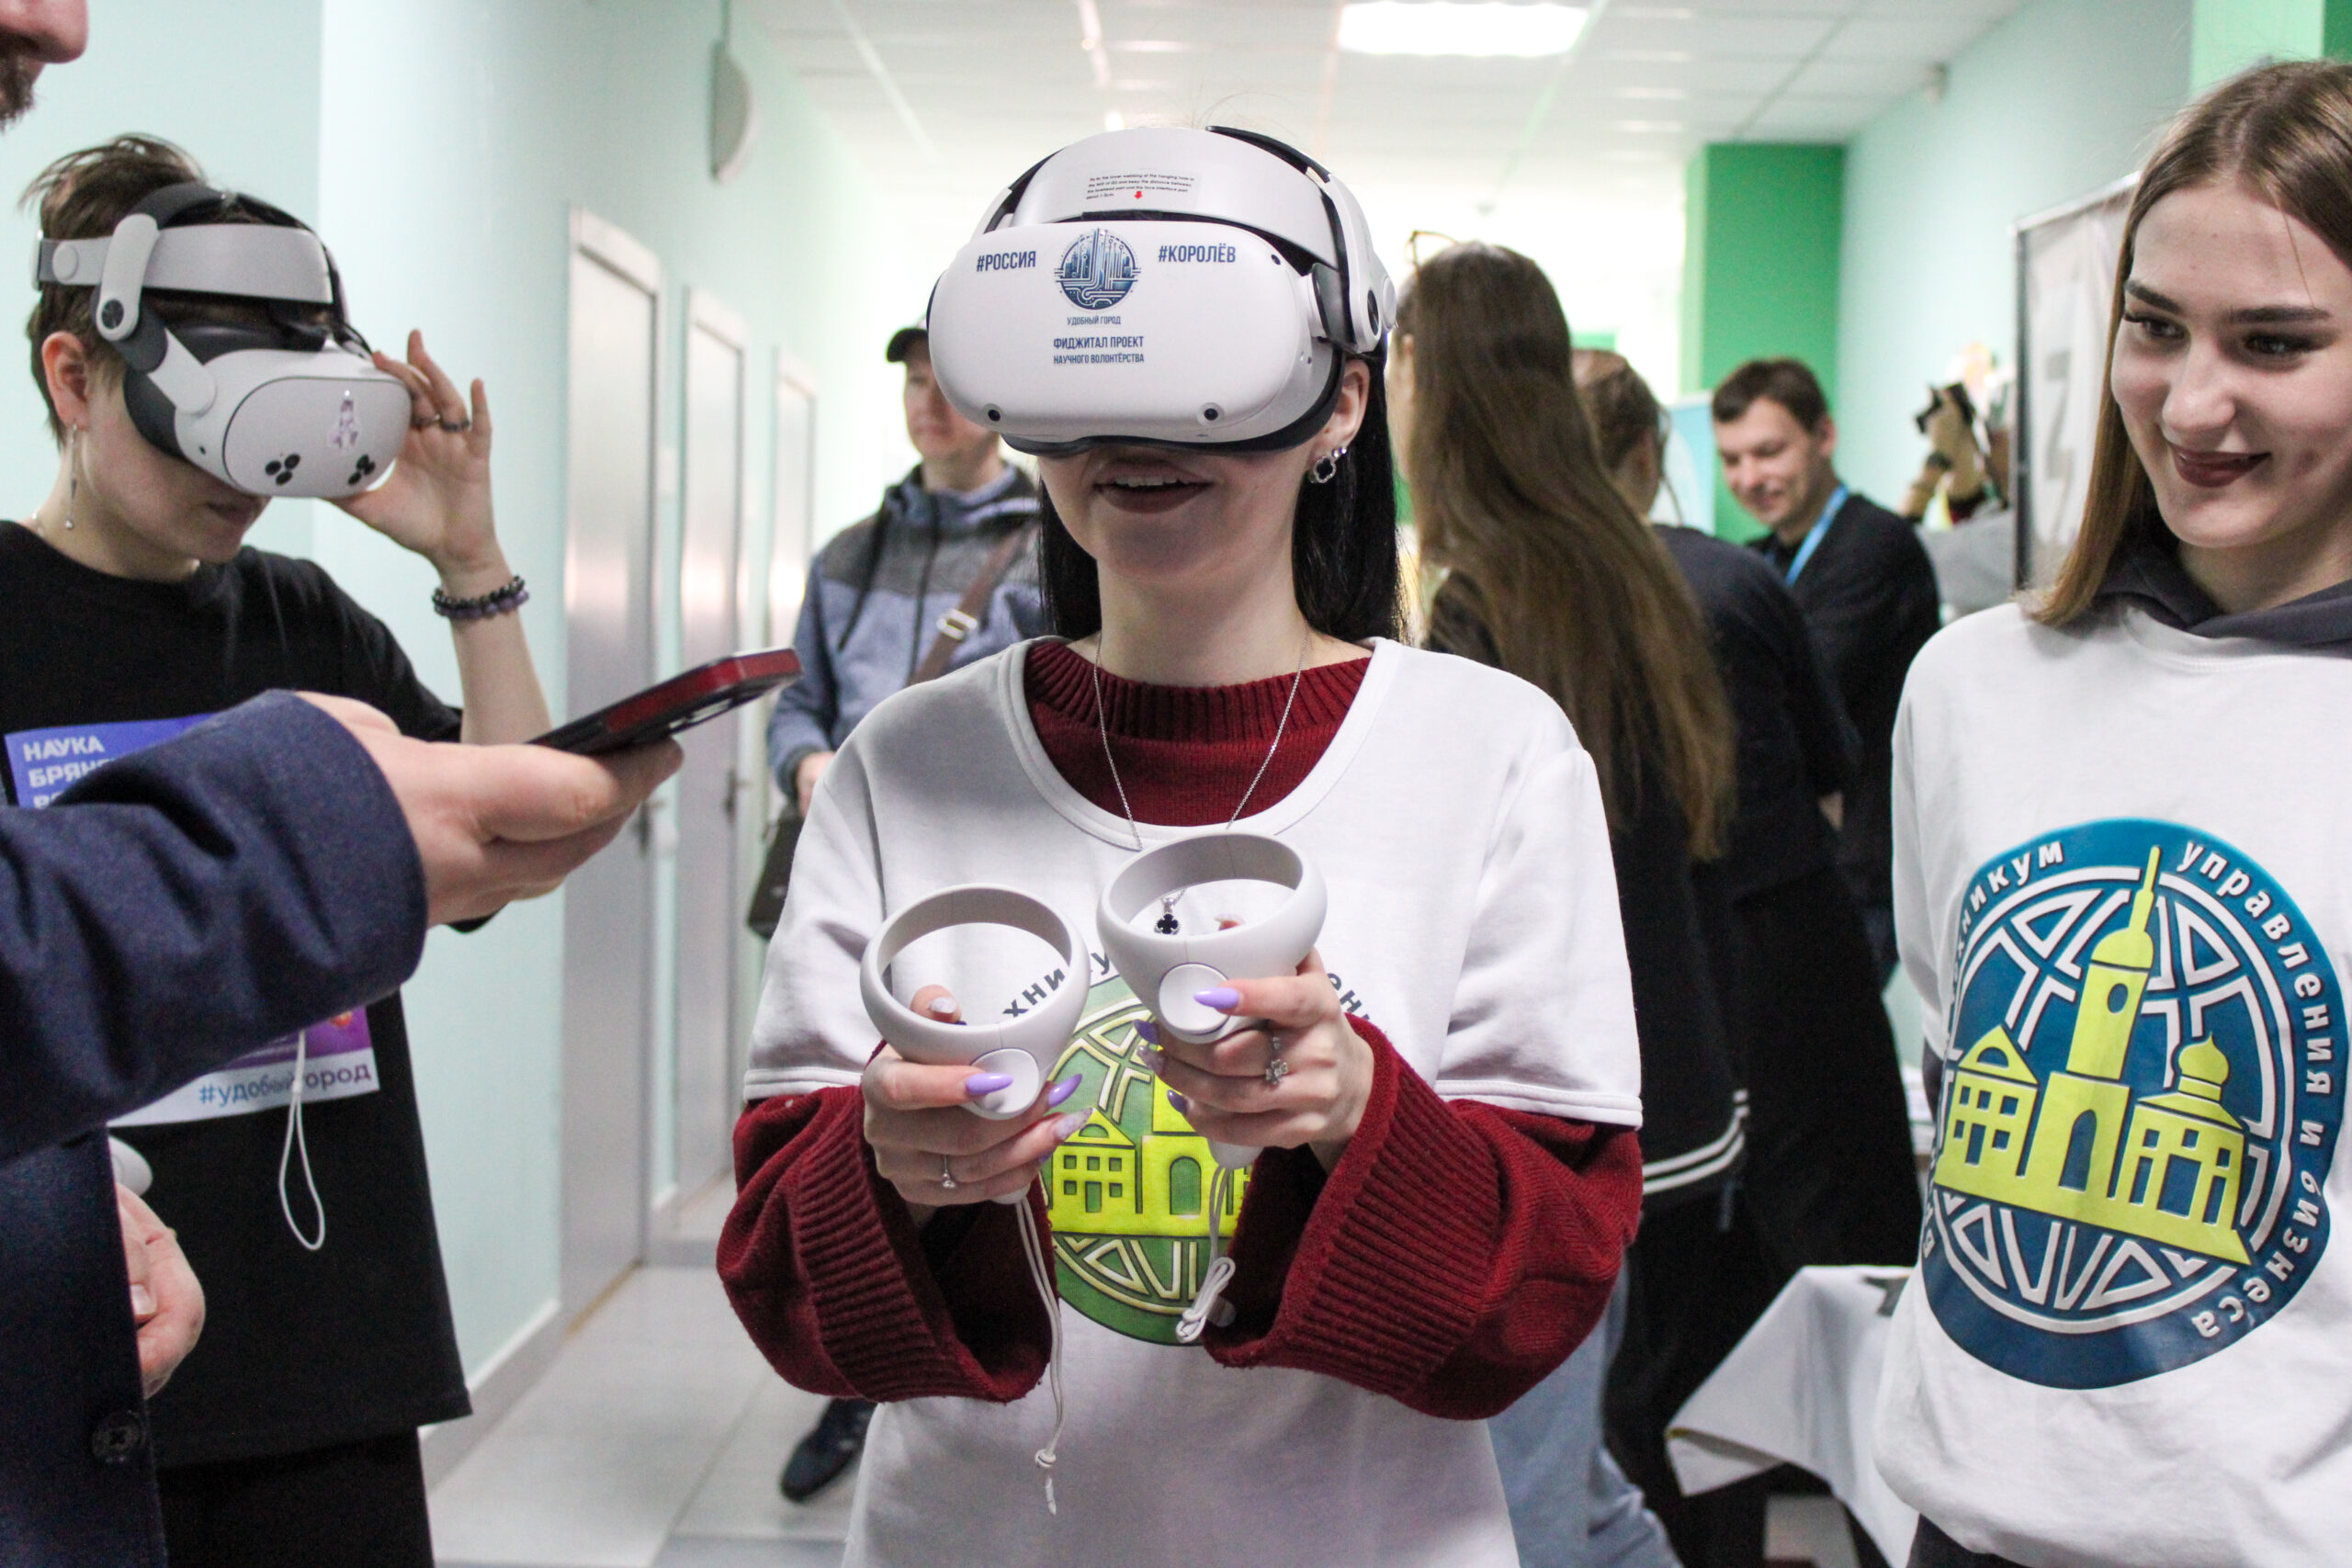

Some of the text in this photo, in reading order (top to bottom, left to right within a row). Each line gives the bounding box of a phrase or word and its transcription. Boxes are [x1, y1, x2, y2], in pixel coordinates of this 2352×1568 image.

[976, 251, 1036, 272] #РОССИЯ
[1159, 243, 1237, 264] #КОРОЛЁВ
[1067, 315, 1122, 326] УДОБНЫЙ ГОРОД
[1053, 336, 1144, 350] ФИДЖИТАЛ ПРОЕКТ
[1053, 353, 1145, 365] НАУЧНОГО ВОЛОНТЁРСТВА
[23, 735, 106, 762] НАУКА
[2177, 840, 2333, 1094] управления
[2300, 1120, 2324, 1146] и
[2191, 1170, 2323, 1337] бизнеса
